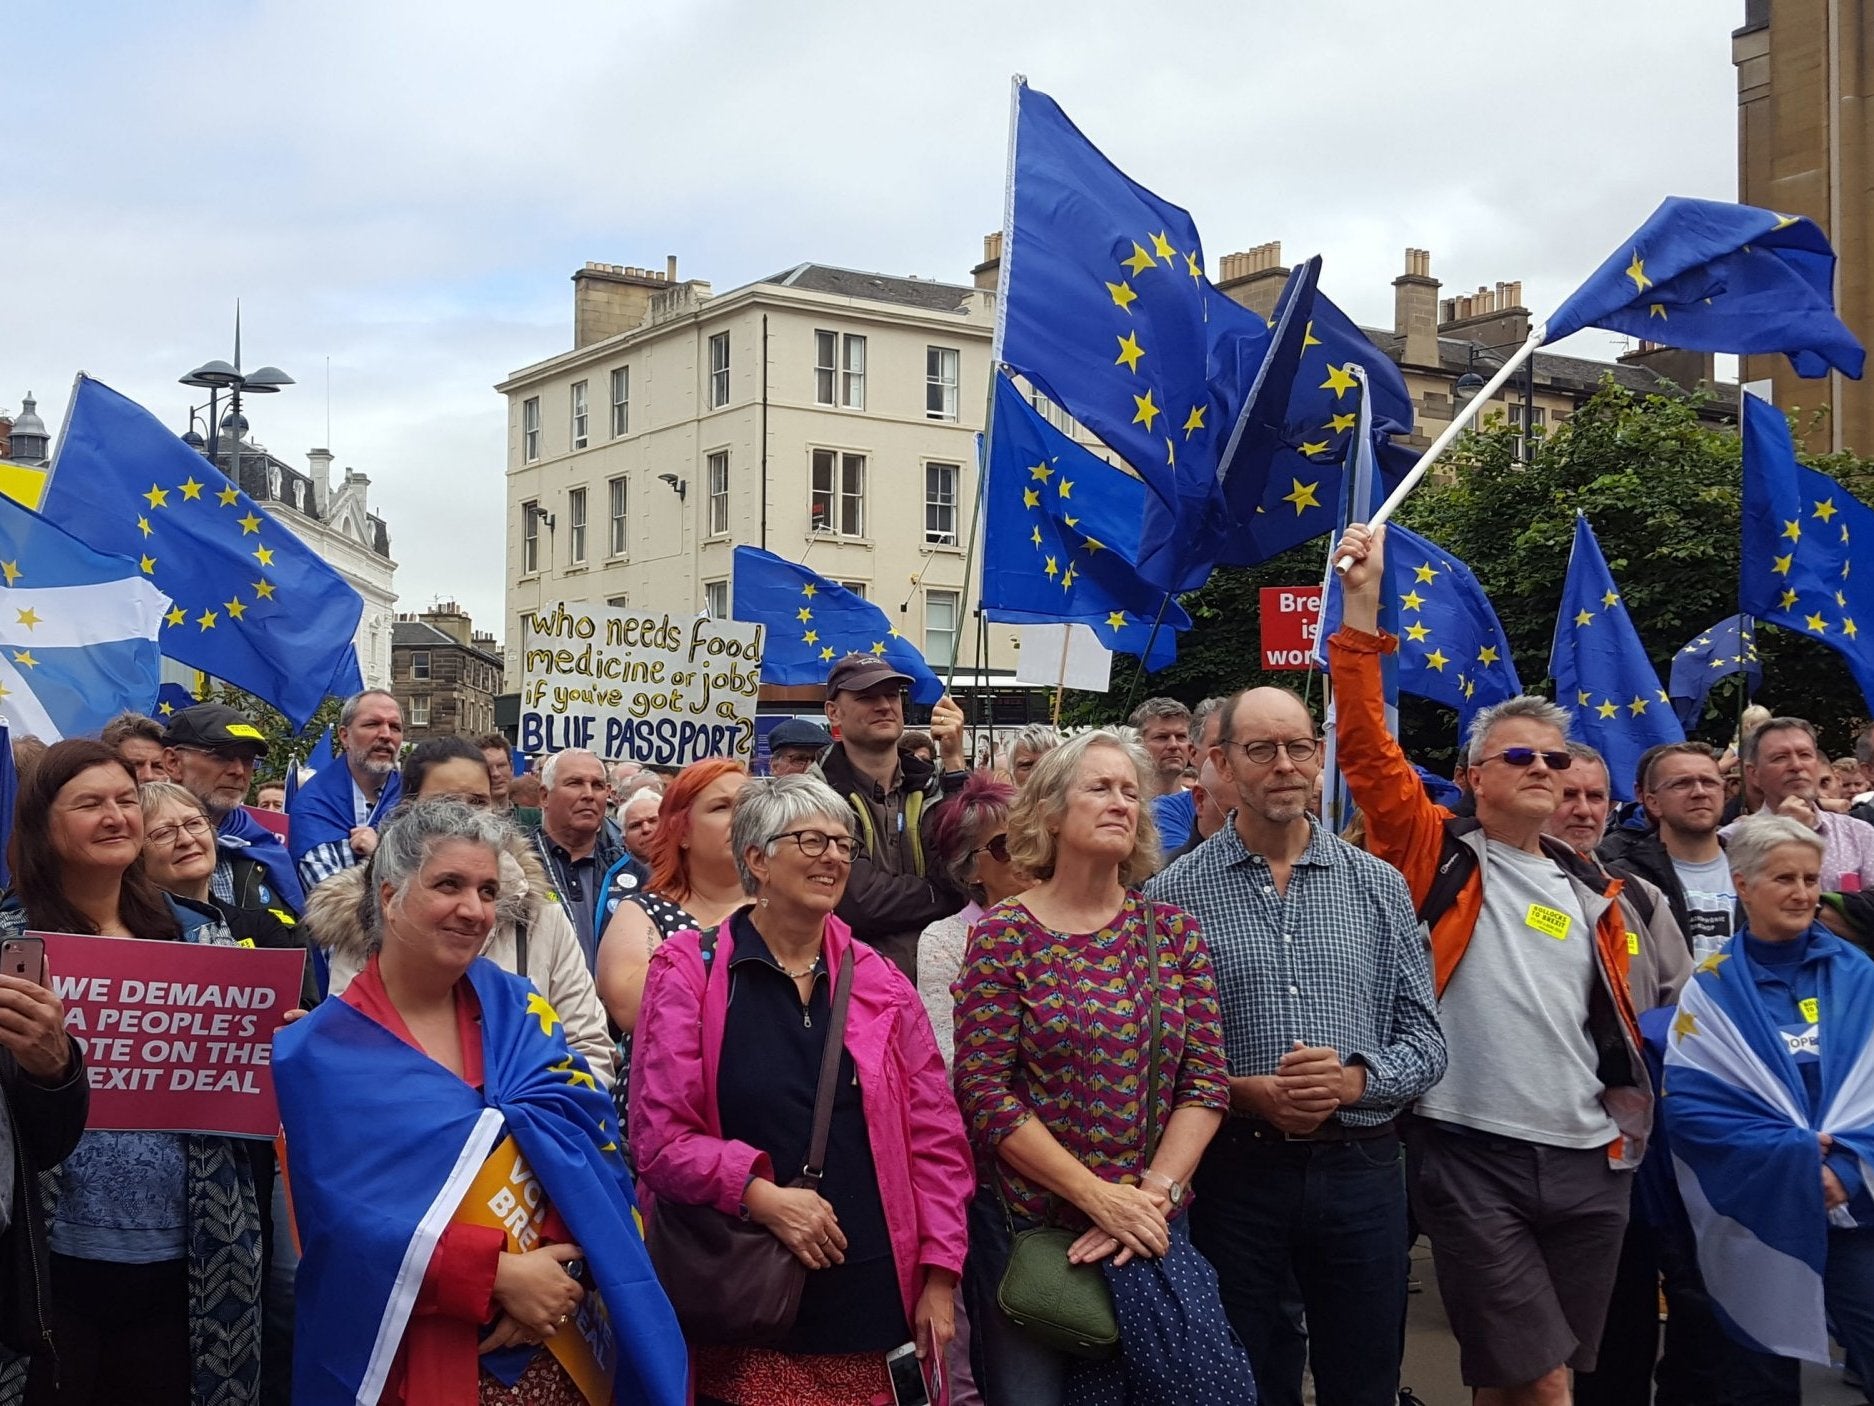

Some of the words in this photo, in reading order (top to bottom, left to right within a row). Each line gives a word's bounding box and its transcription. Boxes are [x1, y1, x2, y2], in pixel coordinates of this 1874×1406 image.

[606, 614, 681, 652] needs
[526, 643, 665, 684] medicine
[671, 671, 697, 687] or
[689, 660, 759, 715] jobs
[525, 679, 548, 708] if
[551, 684, 622, 714] you've
[628, 689, 684, 718] got
[716, 701, 739, 720] a
[604, 716, 754, 767] PASSPORT?
[52, 975, 112, 1002] WE
[119, 980, 276, 1009] DEMAND
[64, 1007, 87, 1030] A
[97, 1008, 258, 1037] PEOPLE'S
[141, 1041, 197, 1063] ON
[206, 1042, 273, 1066] THE
[169, 1069, 262, 1094] DEAL
